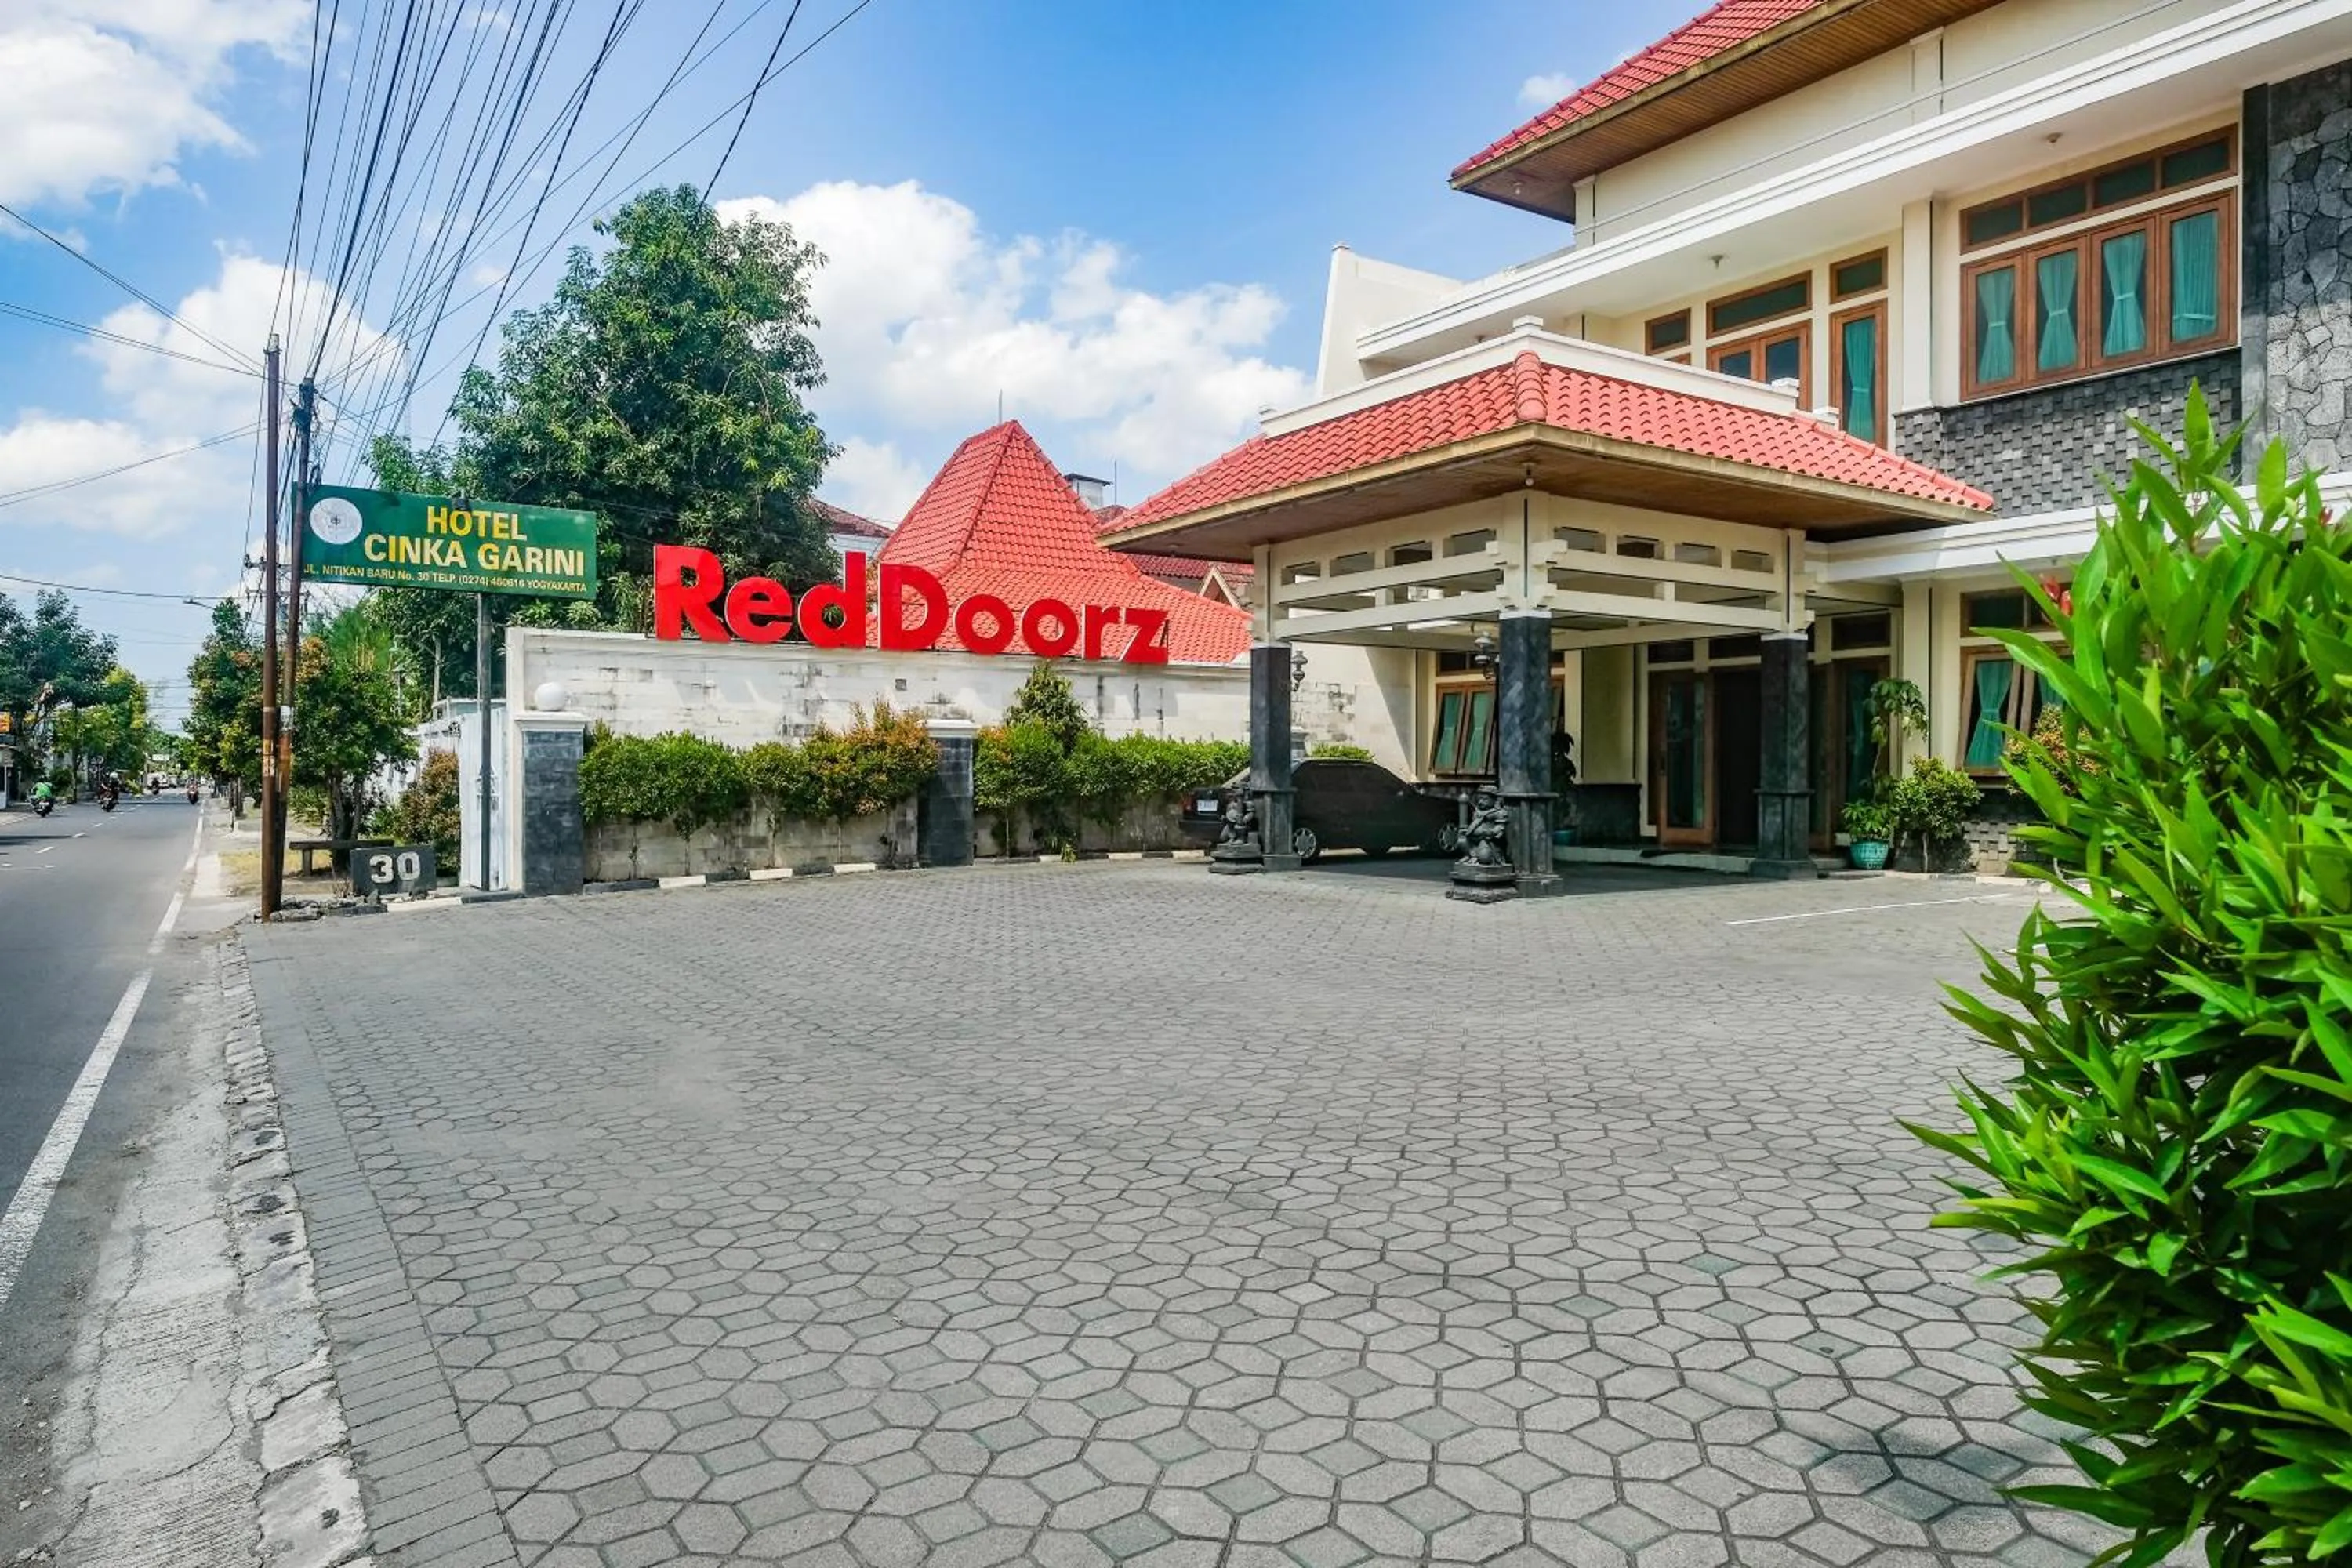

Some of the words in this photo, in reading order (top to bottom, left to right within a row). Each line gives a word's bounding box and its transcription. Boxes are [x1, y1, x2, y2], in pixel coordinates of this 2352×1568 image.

[426, 506, 527, 541] HOTEL
[364, 534, 468, 568] CINKA
[477, 542, 584, 577] GARINI
[322, 565, 365, 578] NITIKAN
[366, 568, 395, 579] BARU
[397, 570, 415, 581] No.
[417, 572, 430, 582] 30
[528, 579, 588, 593] YOGYAKARTA
[653, 543, 1169, 663] RedDoorz
[369, 851, 421, 884] 30
